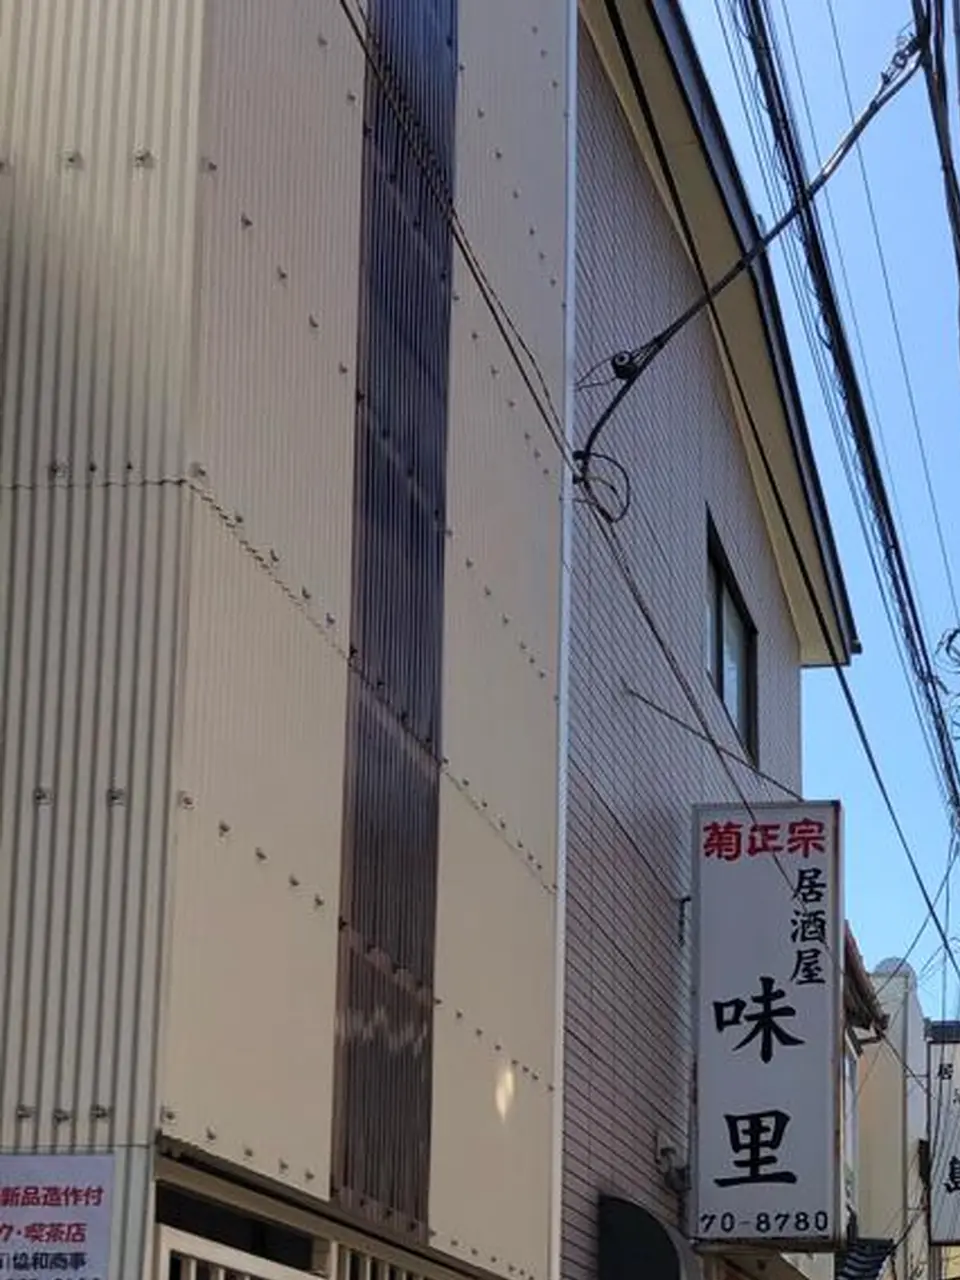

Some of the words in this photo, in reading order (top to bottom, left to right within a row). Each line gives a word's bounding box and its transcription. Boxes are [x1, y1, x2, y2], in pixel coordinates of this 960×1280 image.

[702, 817, 826, 861] 菊正宗
[790, 867, 828, 986] 居酒屋
[713, 976, 806, 1189] 味里
[700, 1211, 829, 1235] 70-8780
